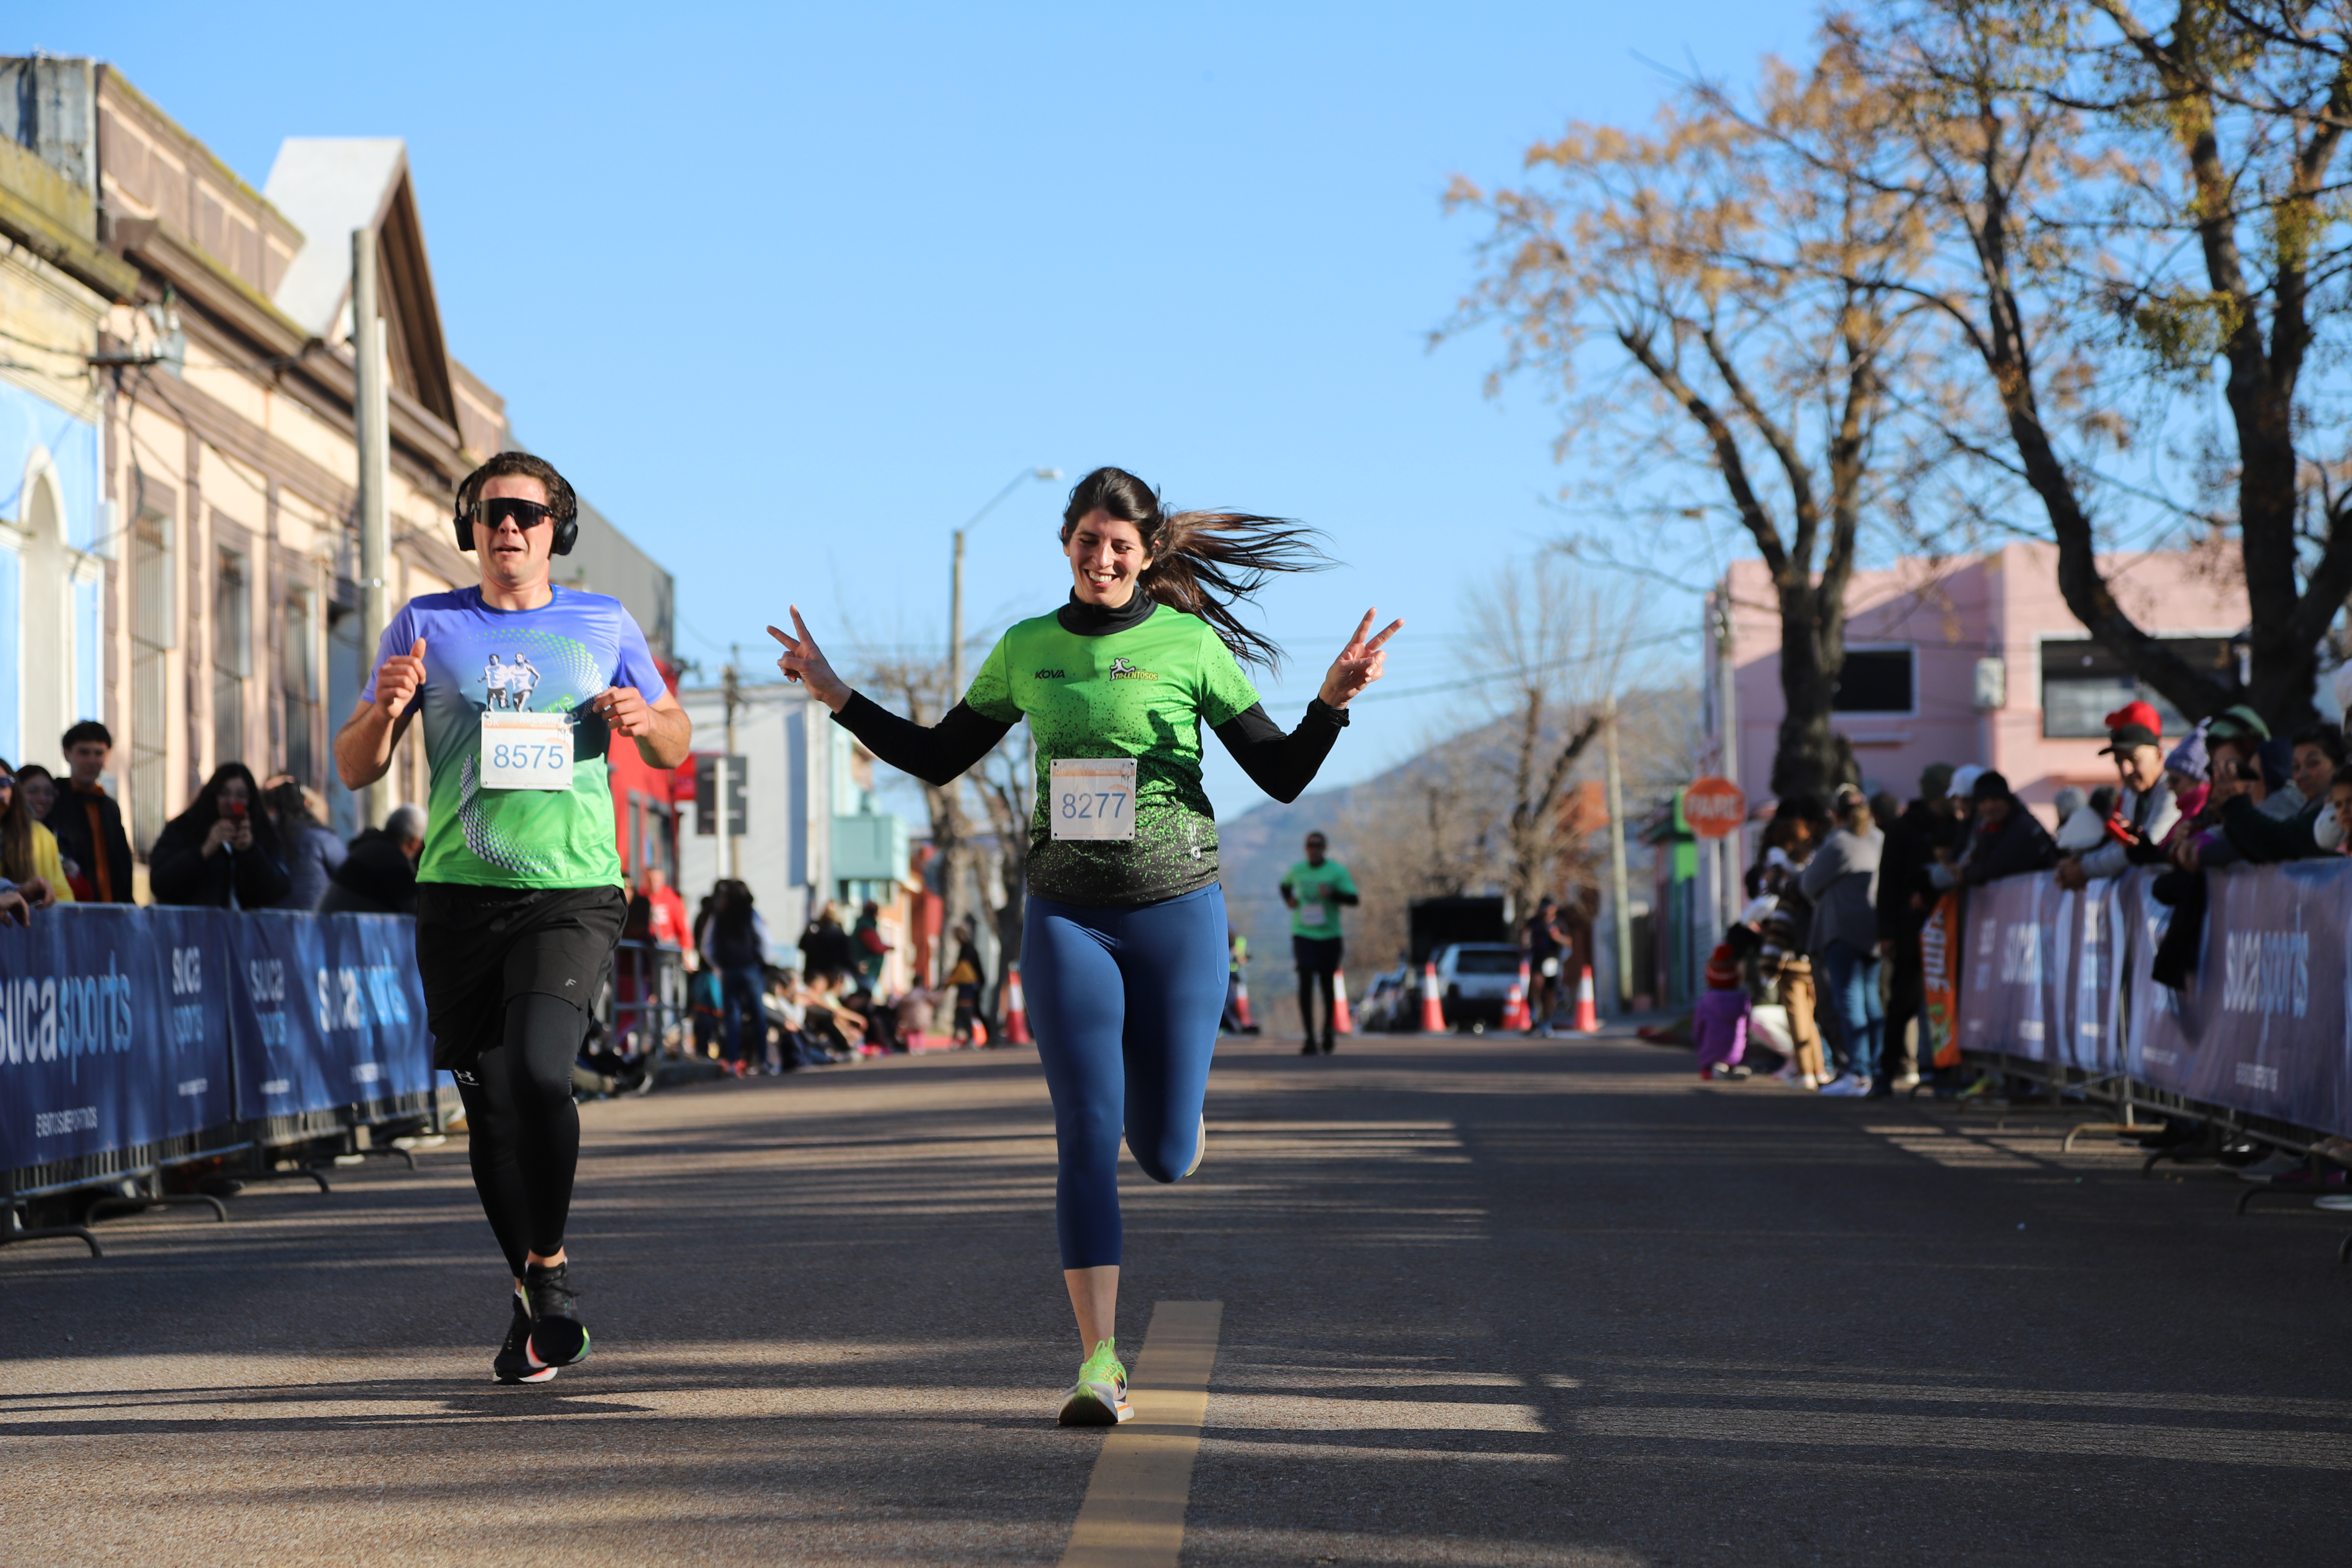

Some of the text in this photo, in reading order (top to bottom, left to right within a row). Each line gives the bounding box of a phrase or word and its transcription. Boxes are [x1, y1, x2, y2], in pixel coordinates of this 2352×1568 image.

[1035, 668, 1066, 679] KOVA
[493, 744, 564, 769] 8575
[1062, 793, 1126, 819] 8277
